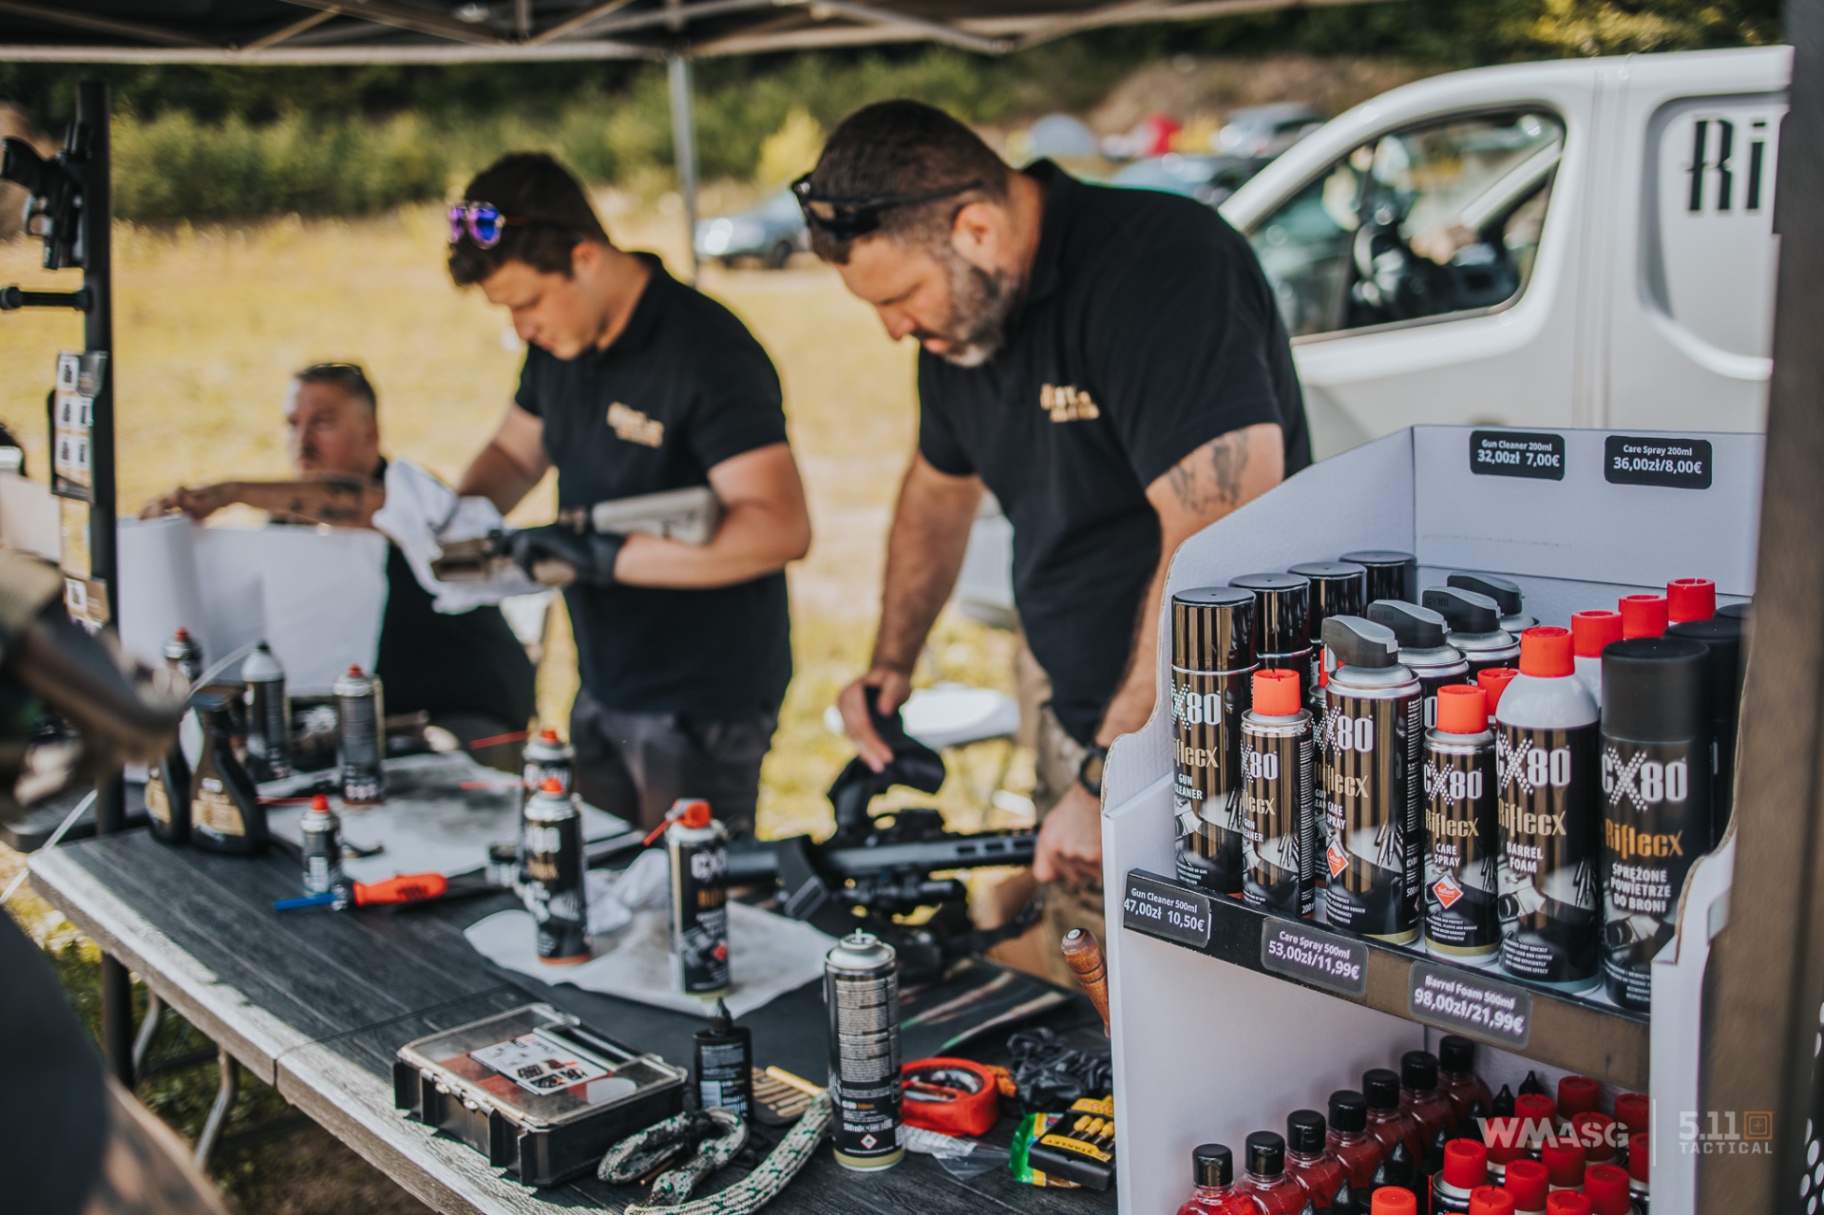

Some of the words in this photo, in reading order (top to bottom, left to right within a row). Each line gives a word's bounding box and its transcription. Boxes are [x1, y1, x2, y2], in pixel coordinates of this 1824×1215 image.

[1481, 438, 1498, 449] Gun
[1499, 439, 1528, 451] Cleaner
[1529, 441, 1552, 452] 200ml
[1623, 444, 1642, 454] Care
[1642, 445, 1666, 457] Spray
[1667, 446, 1692, 456] 200ml
[1477, 449, 1521, 465] 32,00zł
[1526, 453, 1560, 467] 7,00€
[1171, 679, 1222, 731] X80
[1496, 733, 1571, 794] CX80
[1423, 759, 1483, 806] CX80
[1601, 746, 1689, 813] CX80
[1434, 854, 1460, 868] SPRAY
[1436, 843, 1458, 855] CARE
[1506, 841, 1544, 860] BARREL
[1509, 856, 1538, 873] FOAM
[1612, 863, 1668, 883] SPRĘŻONE
[1610, 876, 1672, 898] POWIETRZE
[1131, 888, 1146, 900] Gun
[1147, 892, 1174, 907] Cleaner
[1175, 899, 1198, 914] 500ml
[1613, 892, 1627, 908] DO
[1628, 896, 1667, 913] BRONI
[1123, 898, 1162, 920] 47,00zł
[1167, 910, 1205, 932] 10,50€
[1279, 931, 1299, 944] Care
[1300, 936, 1324, 953] Spray
[1324, 943, 1351, 960] 500ml
[1268, 940, 1361, 981] 53,00zł/11,99€
[1425, 974, 1455, 992] Barrel
[1455, 983, 1483, 1000] Foam
[1484, 991, 1516, 1010] 500ml
[1414, 988, 1525, 1036] 98,00zł/21,99€
